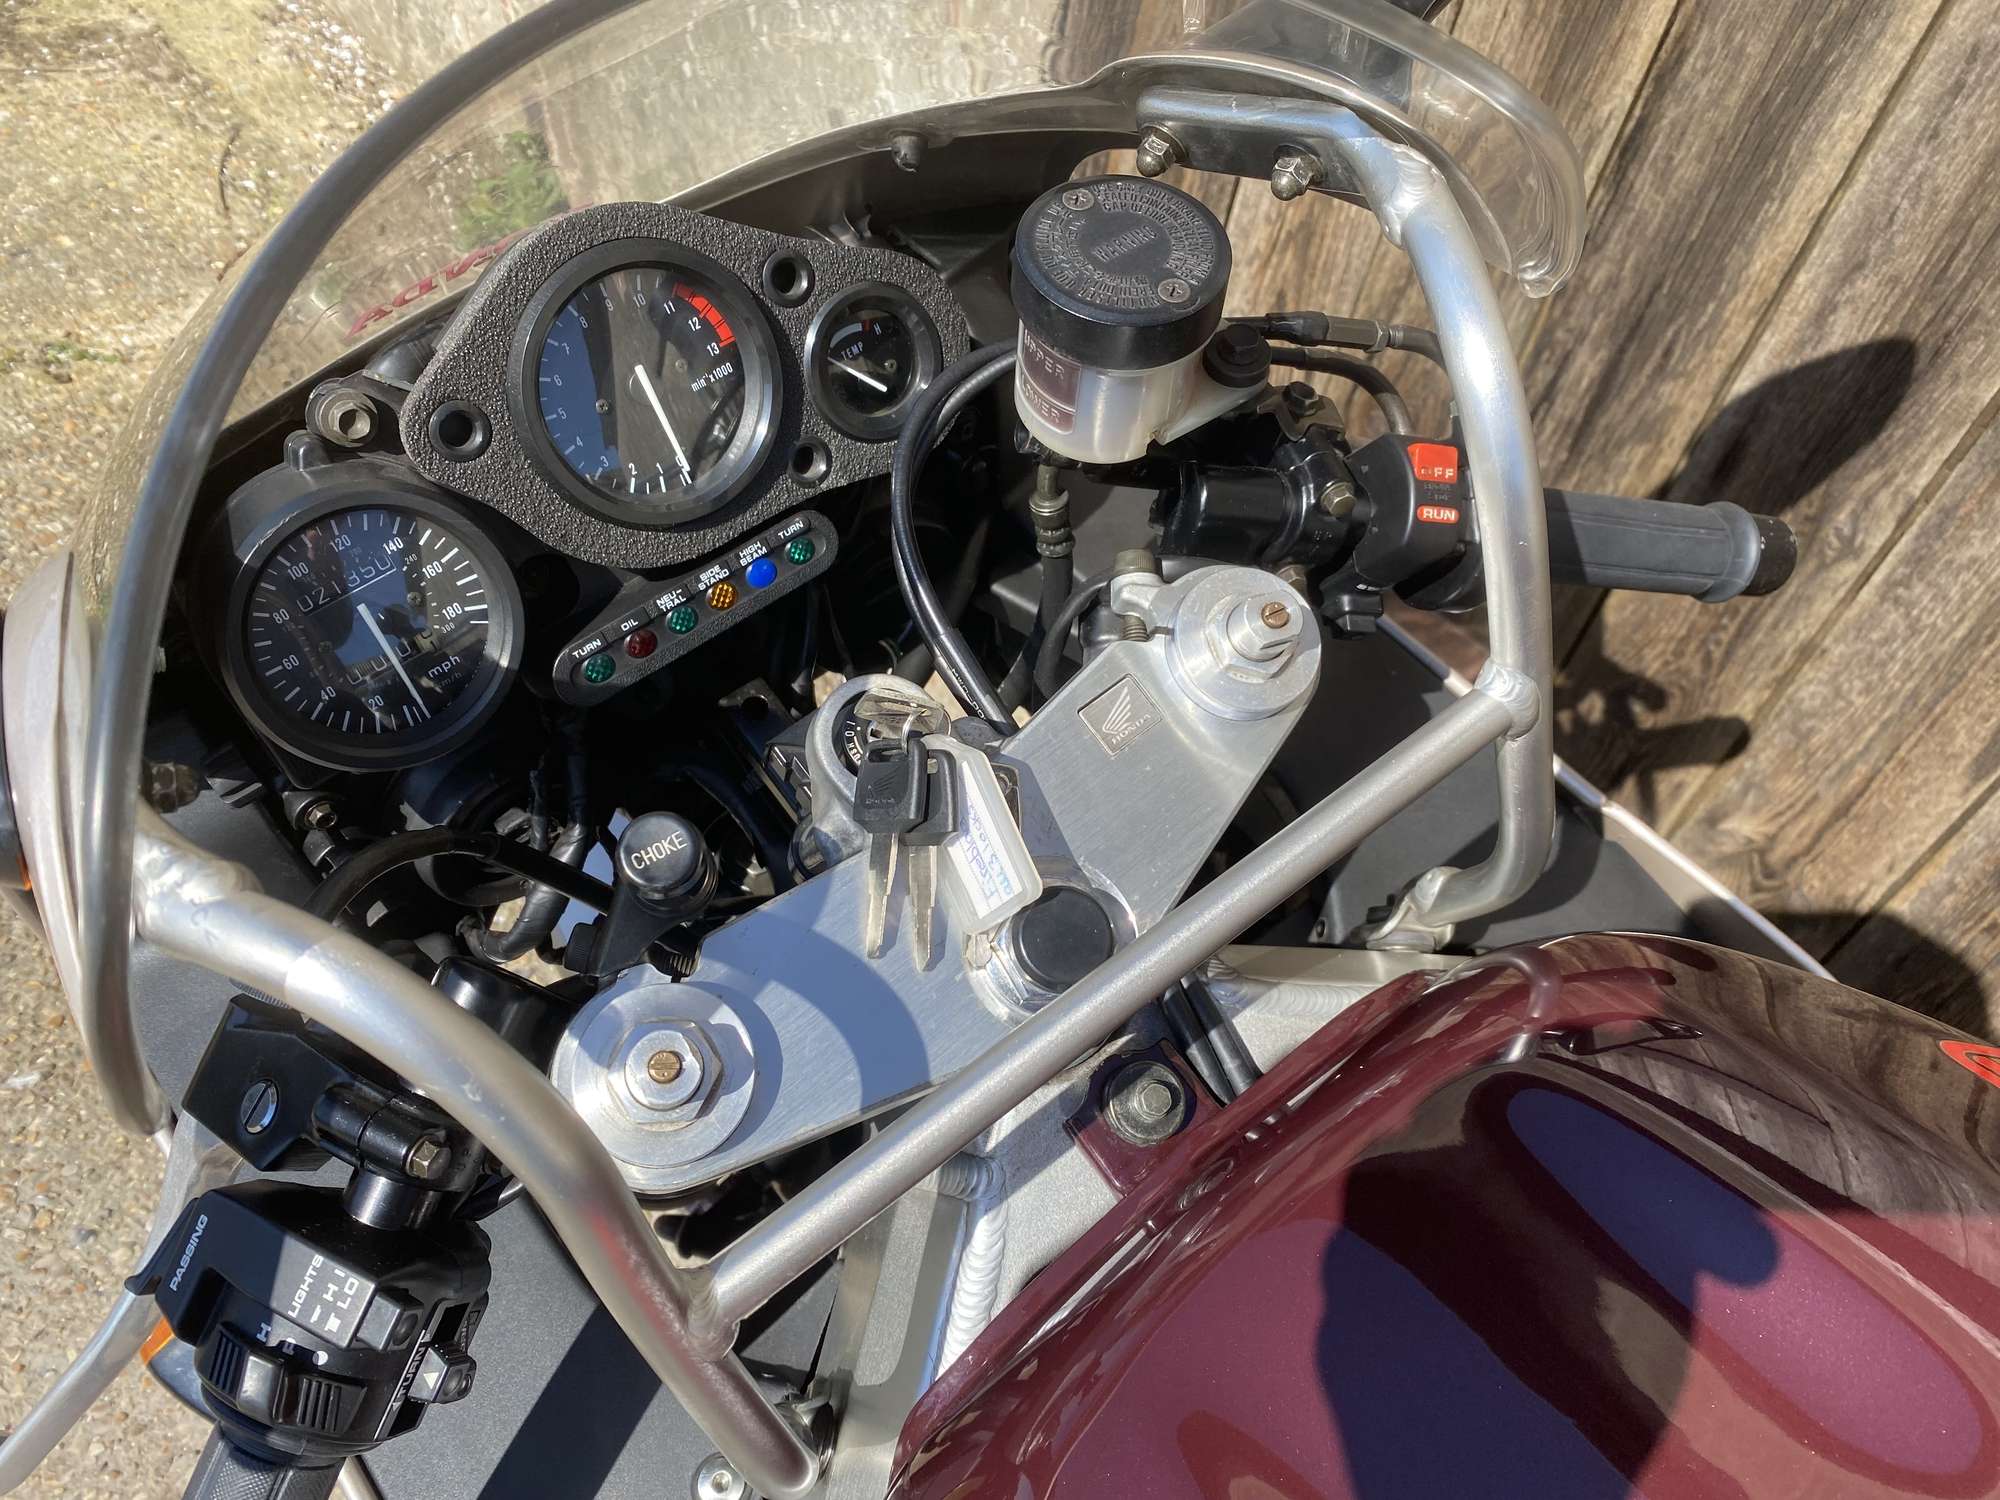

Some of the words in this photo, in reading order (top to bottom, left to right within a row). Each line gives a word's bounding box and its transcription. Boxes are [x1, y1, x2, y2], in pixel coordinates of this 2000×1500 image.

[605, 300, 613, 312] 9
[633, 292, 646, 308] 10
[663, 301, 676, 315] 11
[580, 316, 588, 328] 8
[688, 317, 702, 332] 12
[873, 323, 882, 336] H
[707, 342, 720, 357] 13
[841, 341, 863, 361] TEMP
[1024, 329, 1065, 379] UPPER
[553, 375, 563, 386] 6
[558, 408, 567, 420] 5
[575, 436, 583, 448] 4
[600, 456, 609, 468] 3
[628, 463, 638, 475] 2
[656, 462, 664, 474] 1
[1422, 508, 1455, 520] RUN
[777, 521, 804, 540] TURN
[331, 535, 351, 553] 120
[383, 537, 403, 555] 140
[738, 541, 761, 559] HIGH
[404, 553, 418, 565] 240
[739, 547, 768, 567] BEAM
[288, 562, 309, 581] 100
[422, 561, 443, 580] 160
[699, 565, 722, 582] SIDE
[698, 568, 730, 591] STAND
[656, 588, 683, 607] NEU-
[659, 594, 687, 613] TRAL
[273, 608, 289, 624] 80
[442, 603, 463, 621] 180
[620, 618, 639, 632] OIL
[572, 639, 602, 660] TURN
[282, 655, 299, 670] 60
[428, 655, 460, 679] mph
[320, 686, 336, 701] 40
[368, 696, 384, 711] 20
[631, 831, 688, 869] CHOKE
[169, 1214, 210, 1292] PASSING
[288, 1254, 323, 1318] LIGHTS
[338, 1276, 359, 1310] LO
[397, 1347, 426, 1398] TURN
